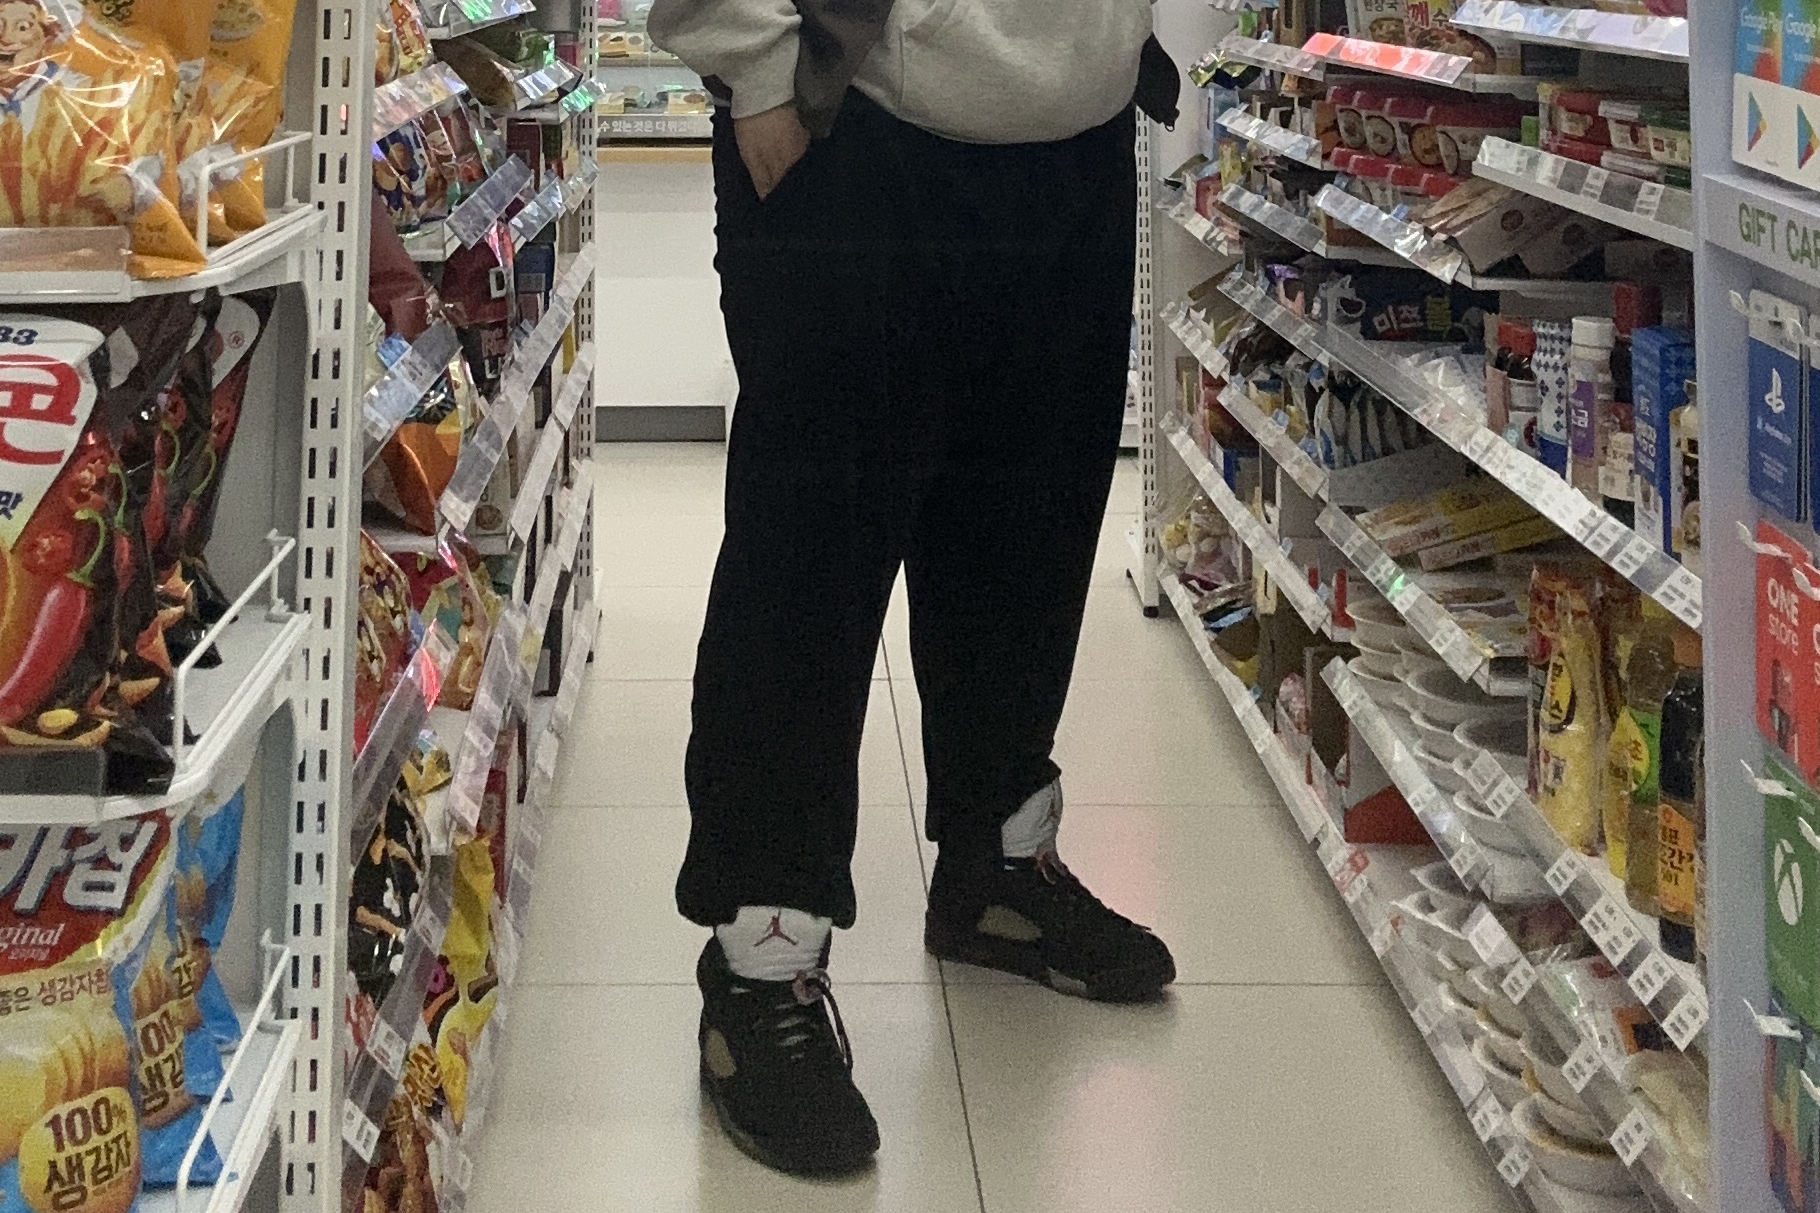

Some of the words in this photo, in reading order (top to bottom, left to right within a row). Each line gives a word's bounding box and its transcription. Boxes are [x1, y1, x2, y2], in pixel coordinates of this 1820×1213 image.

[1738, 202, 1778, 254] GIFT
[1767, 577, 1799, 627] ONE
[44, 1095, 128, 1152] 100%
[44, 1136, 132, 1211] 생감자
